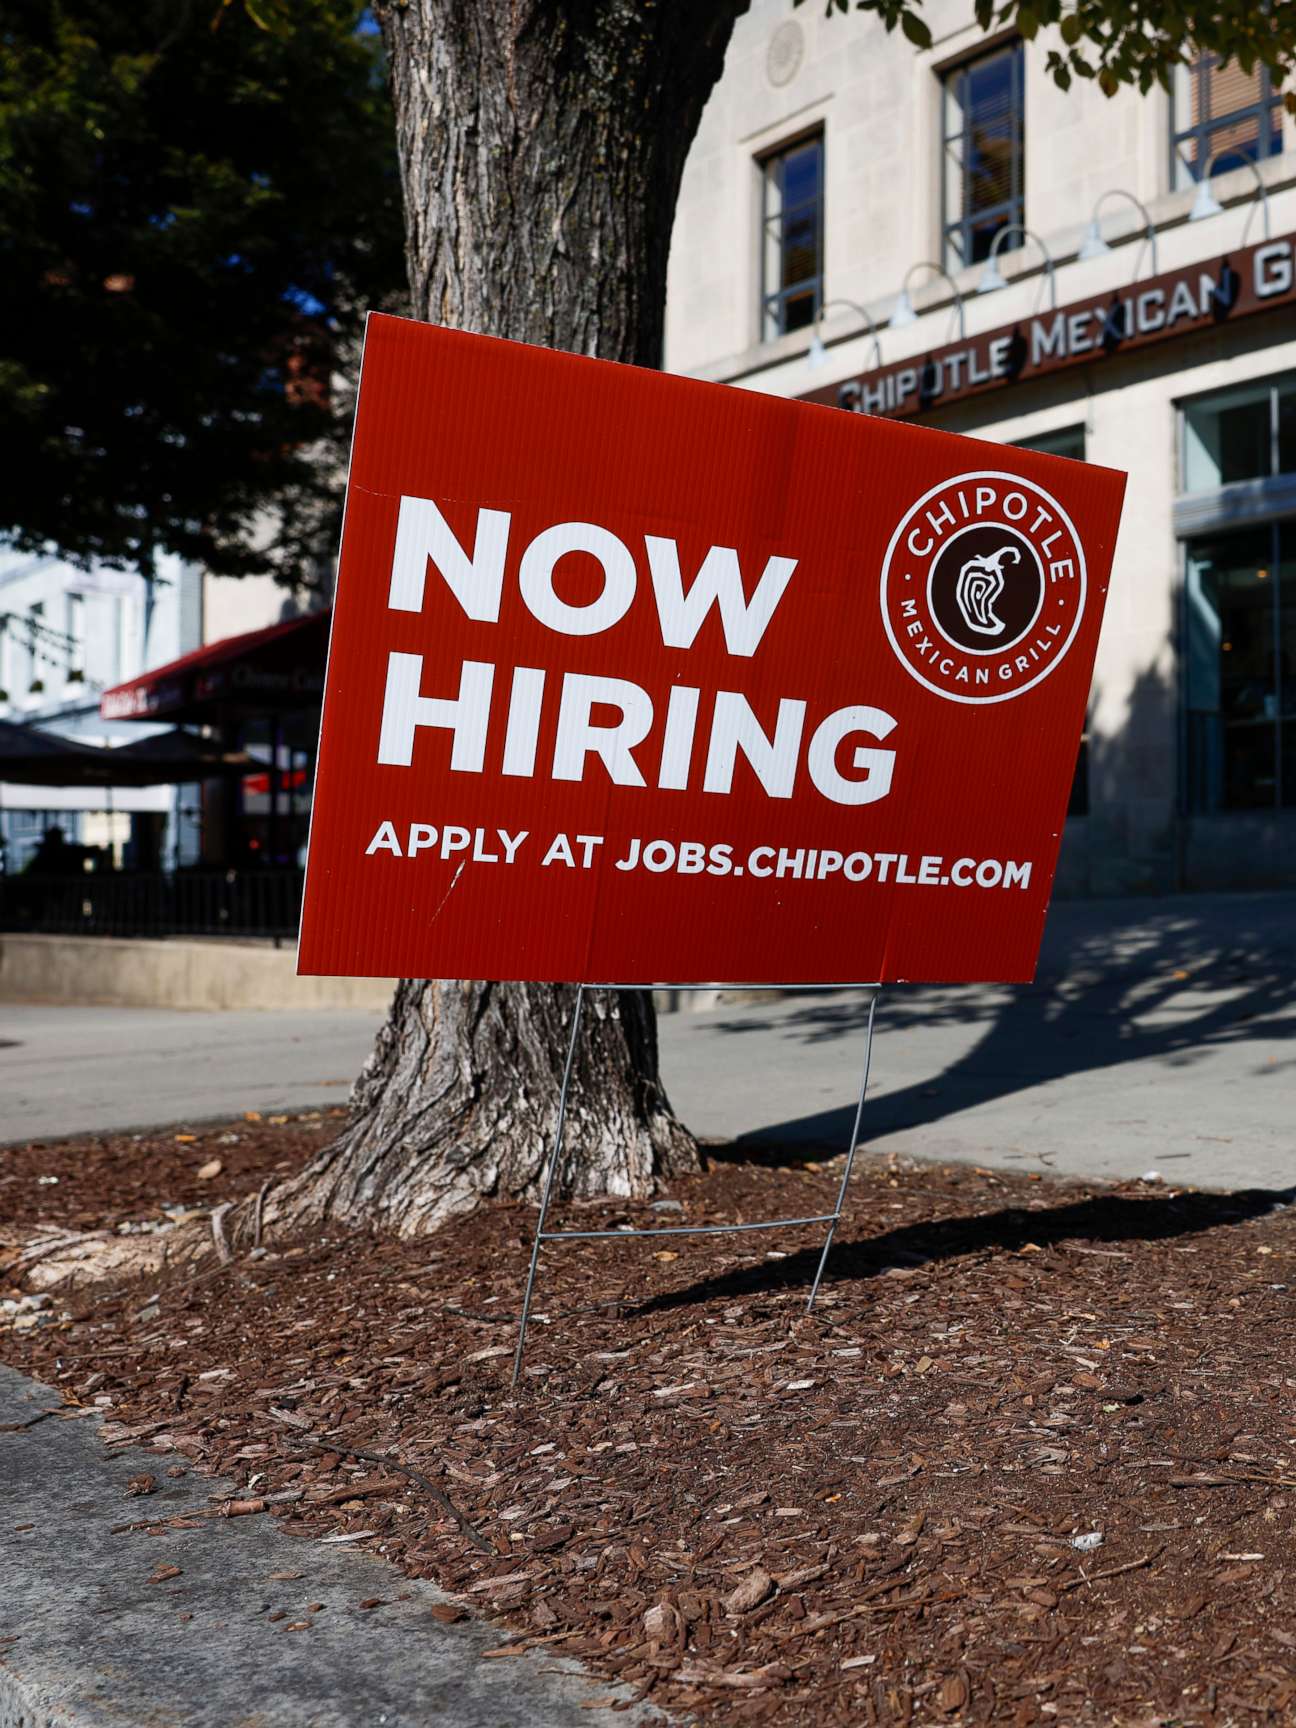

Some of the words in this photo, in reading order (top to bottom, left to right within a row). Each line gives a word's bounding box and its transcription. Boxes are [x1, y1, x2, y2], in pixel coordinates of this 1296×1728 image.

[838, 335, 1013, 415] CHIPOTLE
[1030, 264, 1232, 367] MEXICAN
[388, 495, 799, 657] NOW
[907, 487, 1075, 583] CHIPOTLE
[901, 599, 989, 684] MEXICAN
[999, 623, 1061, 680] GRILL
[377, 651, 898, 806] HIRING
[365, 820, 530, 864] APPLY
[541, 833, 604, 869] AT
[615, 838, 1033, 889] JOBS.CHIPOTLE.COM
